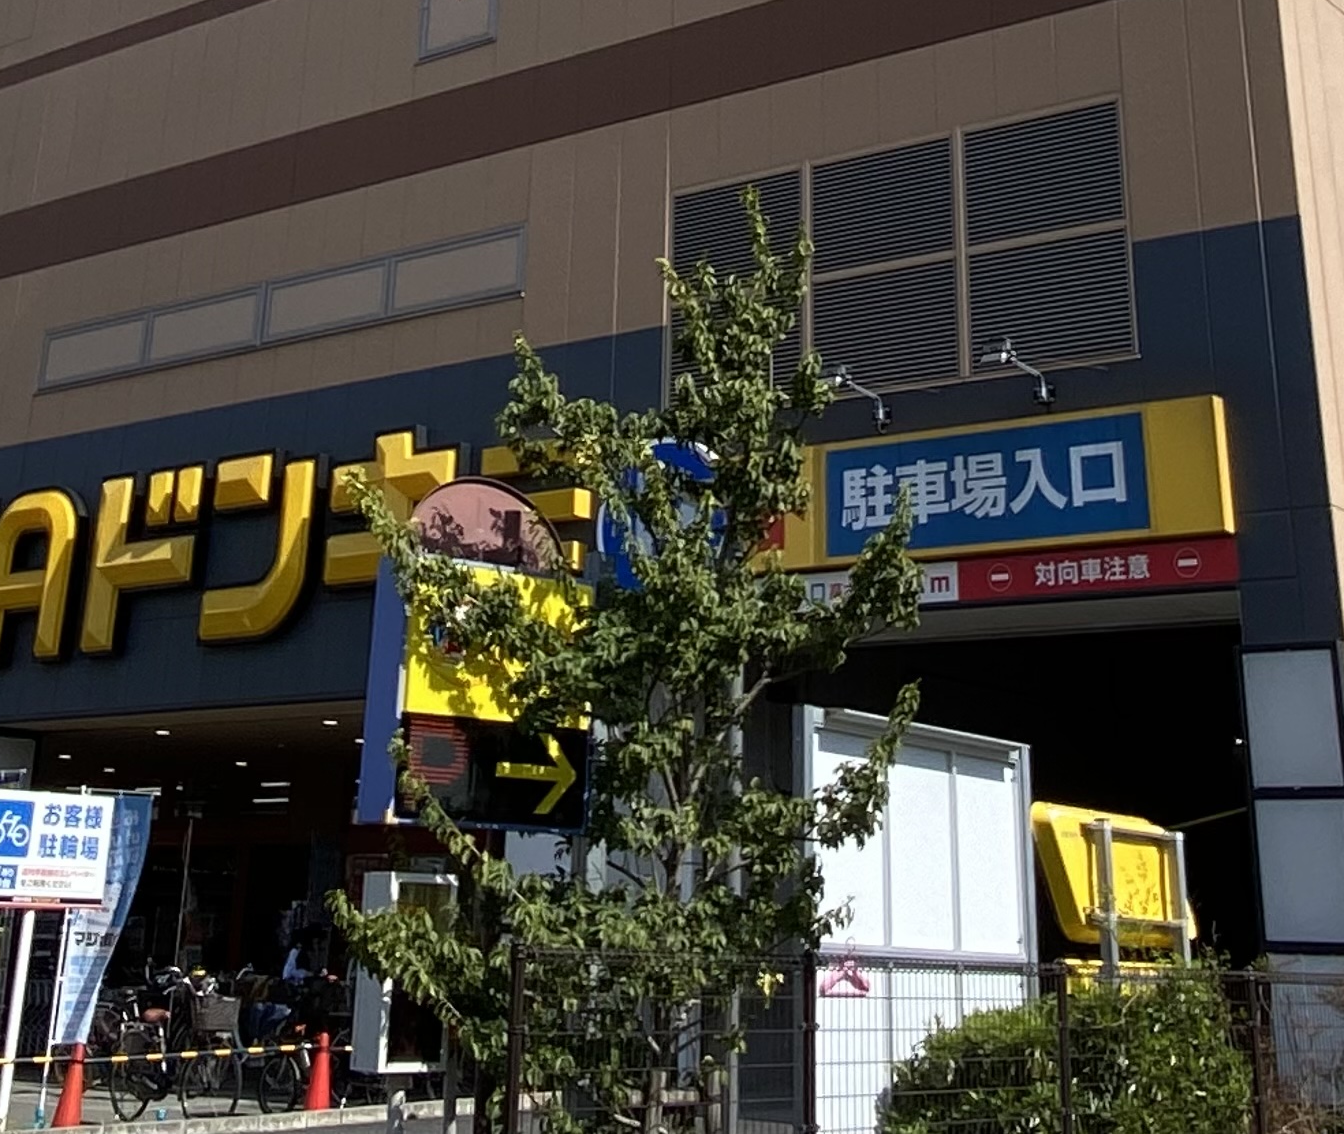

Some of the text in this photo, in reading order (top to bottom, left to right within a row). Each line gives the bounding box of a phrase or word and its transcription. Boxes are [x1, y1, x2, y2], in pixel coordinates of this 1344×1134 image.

[841, 440, 1127, 531] 駐車場入口
[1035, 554, 1151, 586] 対向車注意
[42, 803, 104, 829] お客様
[38, 833, 100, 860] 駐輪場
